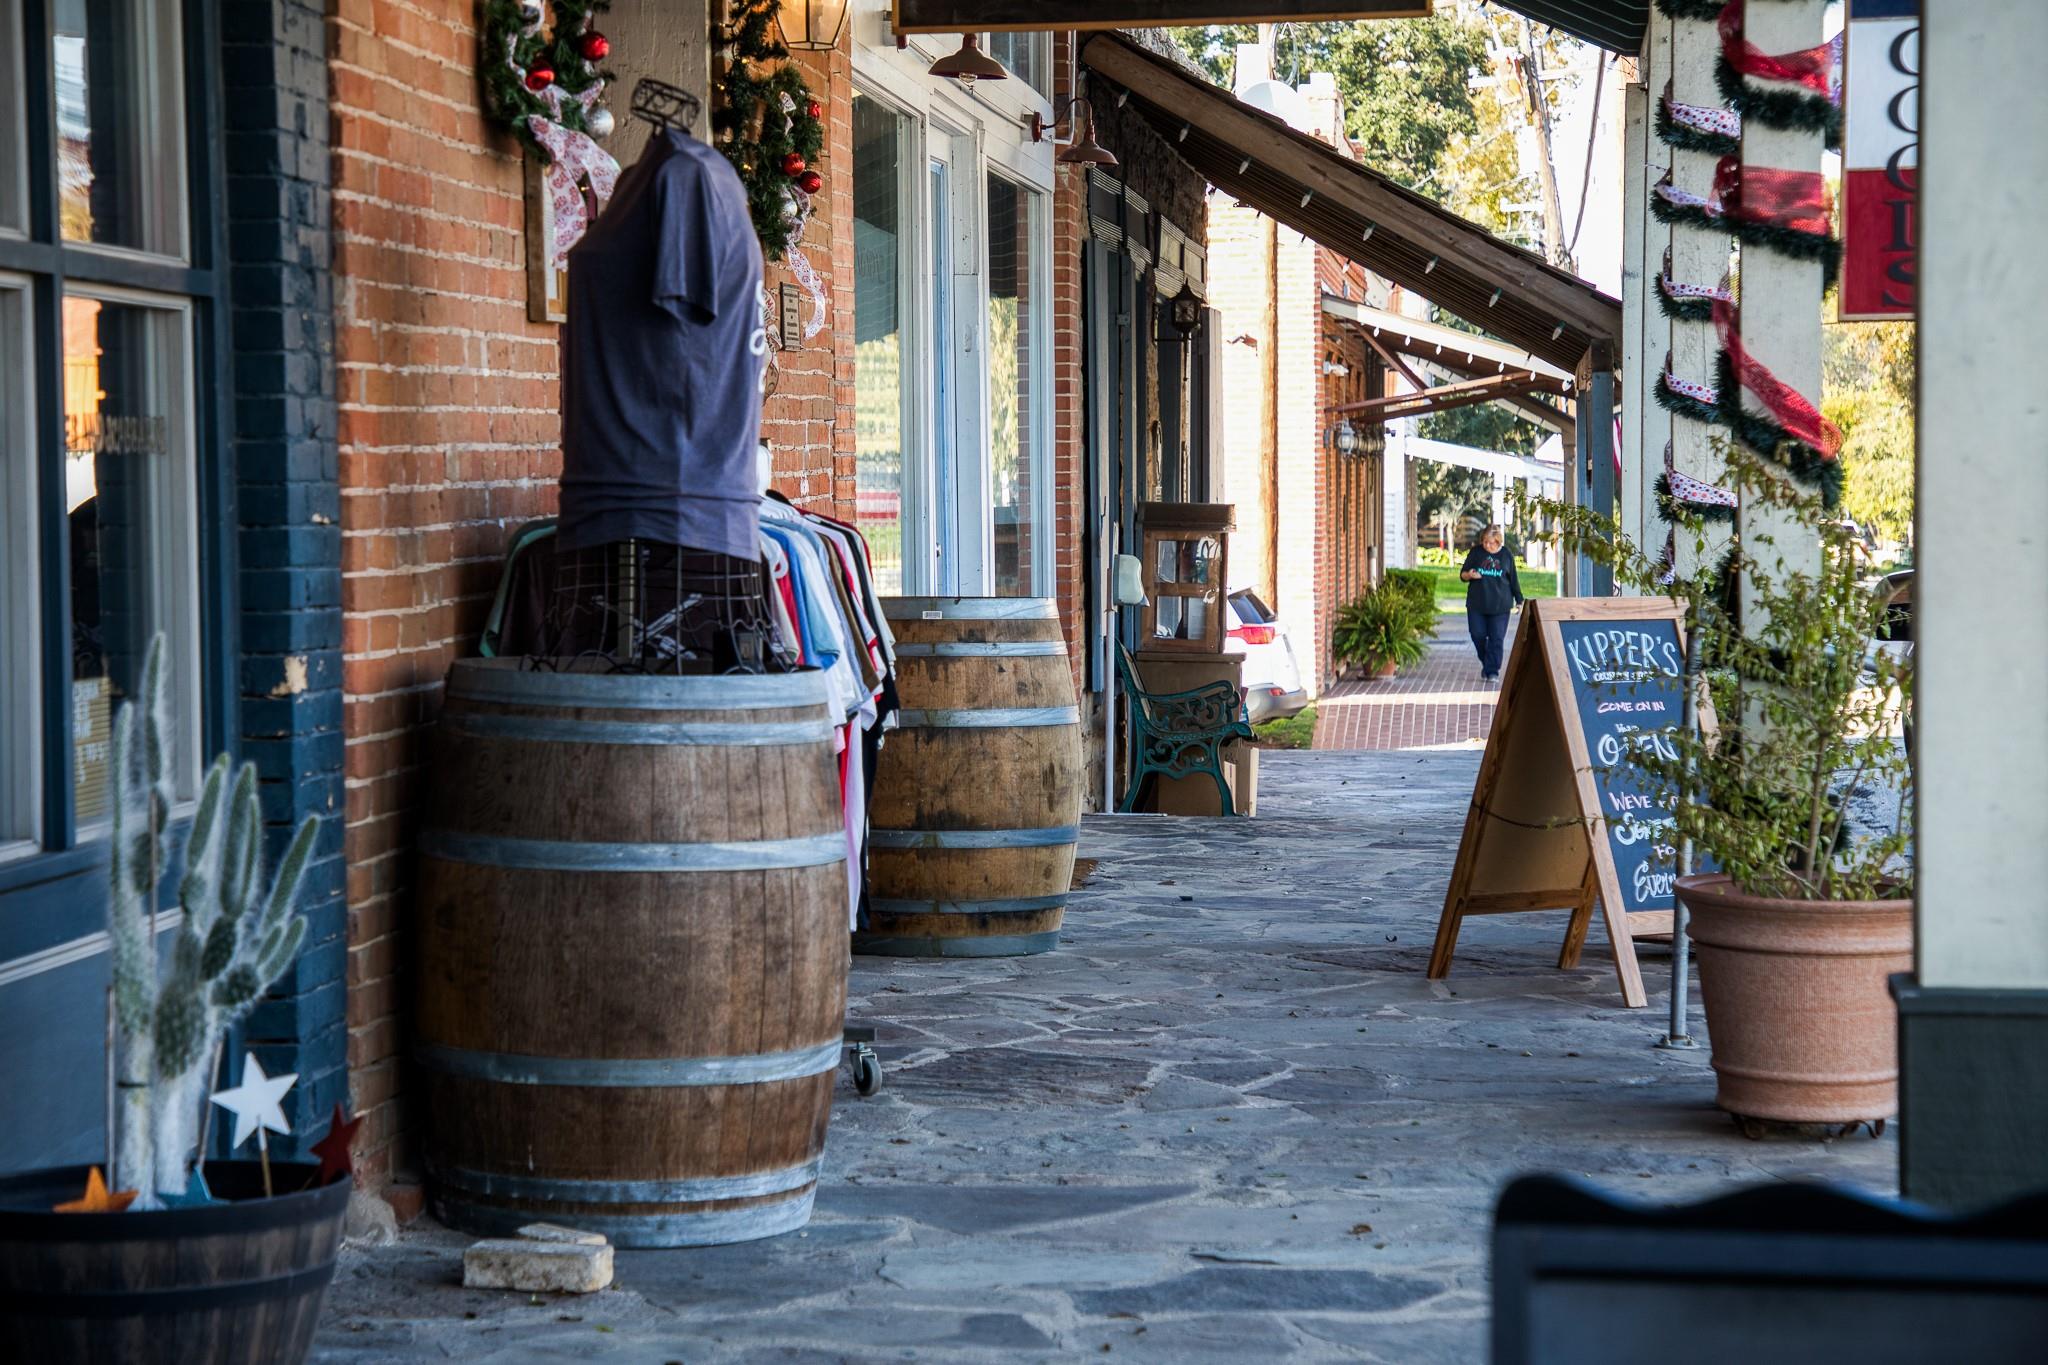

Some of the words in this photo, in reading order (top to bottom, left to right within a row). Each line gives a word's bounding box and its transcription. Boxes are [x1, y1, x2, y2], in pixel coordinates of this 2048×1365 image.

[1568, 630, 1679, 681] KIPPER'S
[1597, 701, 1634, 714] COME
[1635, 701, 1651, 712] ON
[1652, 701, 1666, 711] IN
